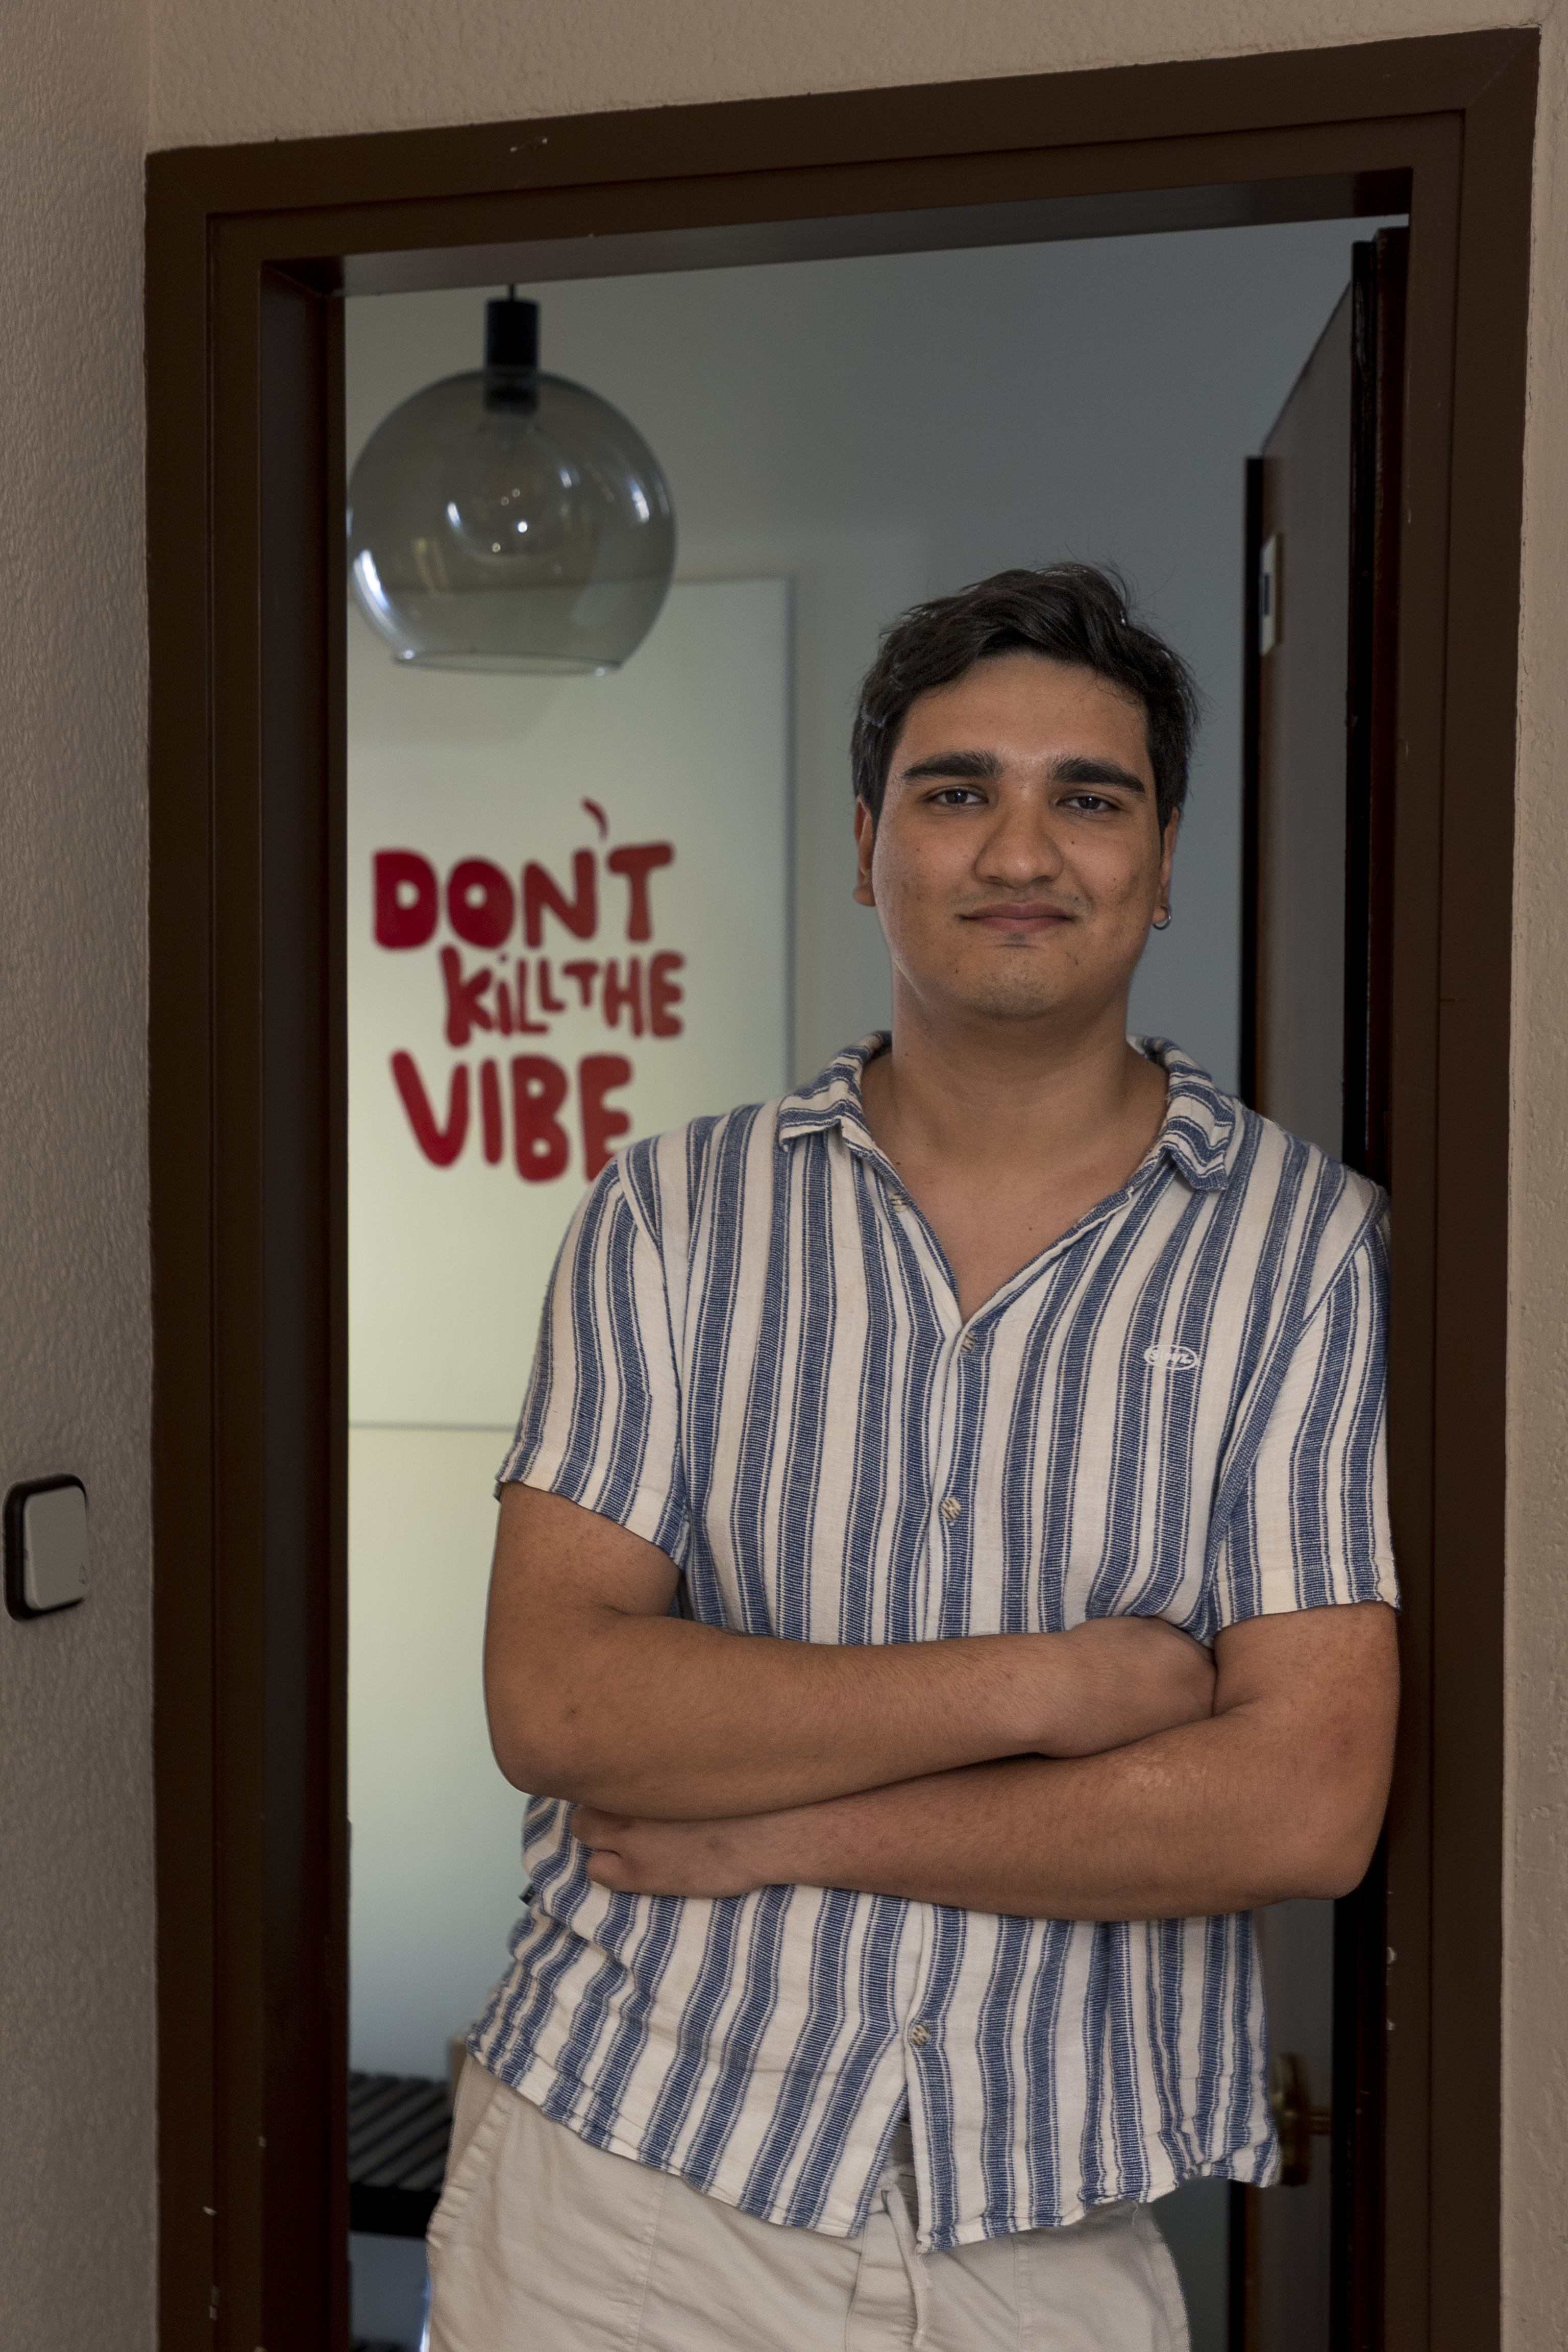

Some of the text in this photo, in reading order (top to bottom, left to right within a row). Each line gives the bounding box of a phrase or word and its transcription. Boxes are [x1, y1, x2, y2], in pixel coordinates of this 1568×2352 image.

[372, 797, 675, 951] DON'T
[561, 949, 685, 1039] THE
[389, 1048, 634, 1184] VIBE
